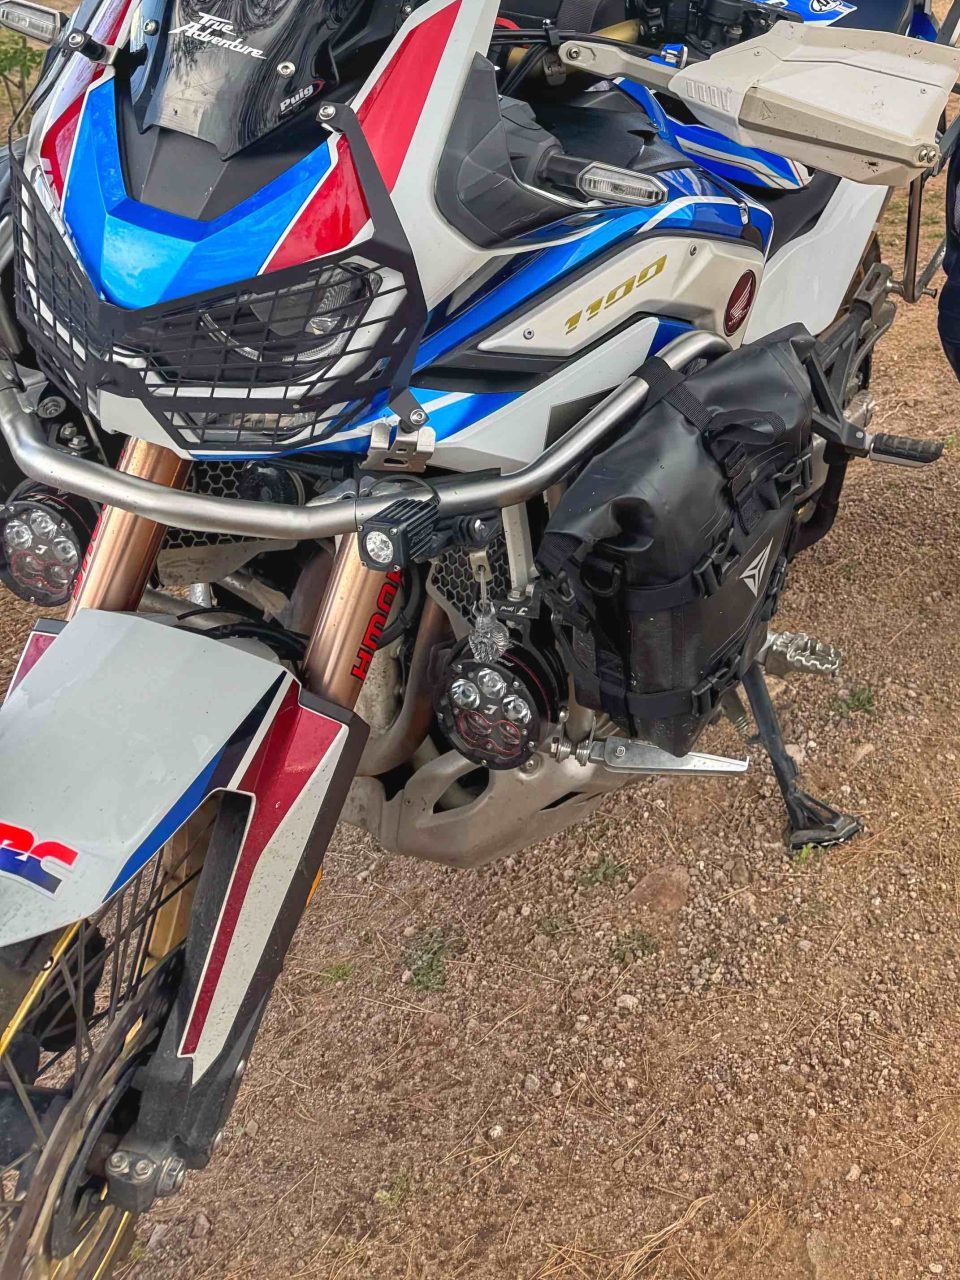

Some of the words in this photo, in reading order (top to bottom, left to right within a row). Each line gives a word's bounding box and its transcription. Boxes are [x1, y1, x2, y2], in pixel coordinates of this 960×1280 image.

[168, 21, 267, 60] Adventure
[199, 12, 236, 36] True
[280, 84, 314, 112] Puig
[564, 254, 667, 336] 1100
